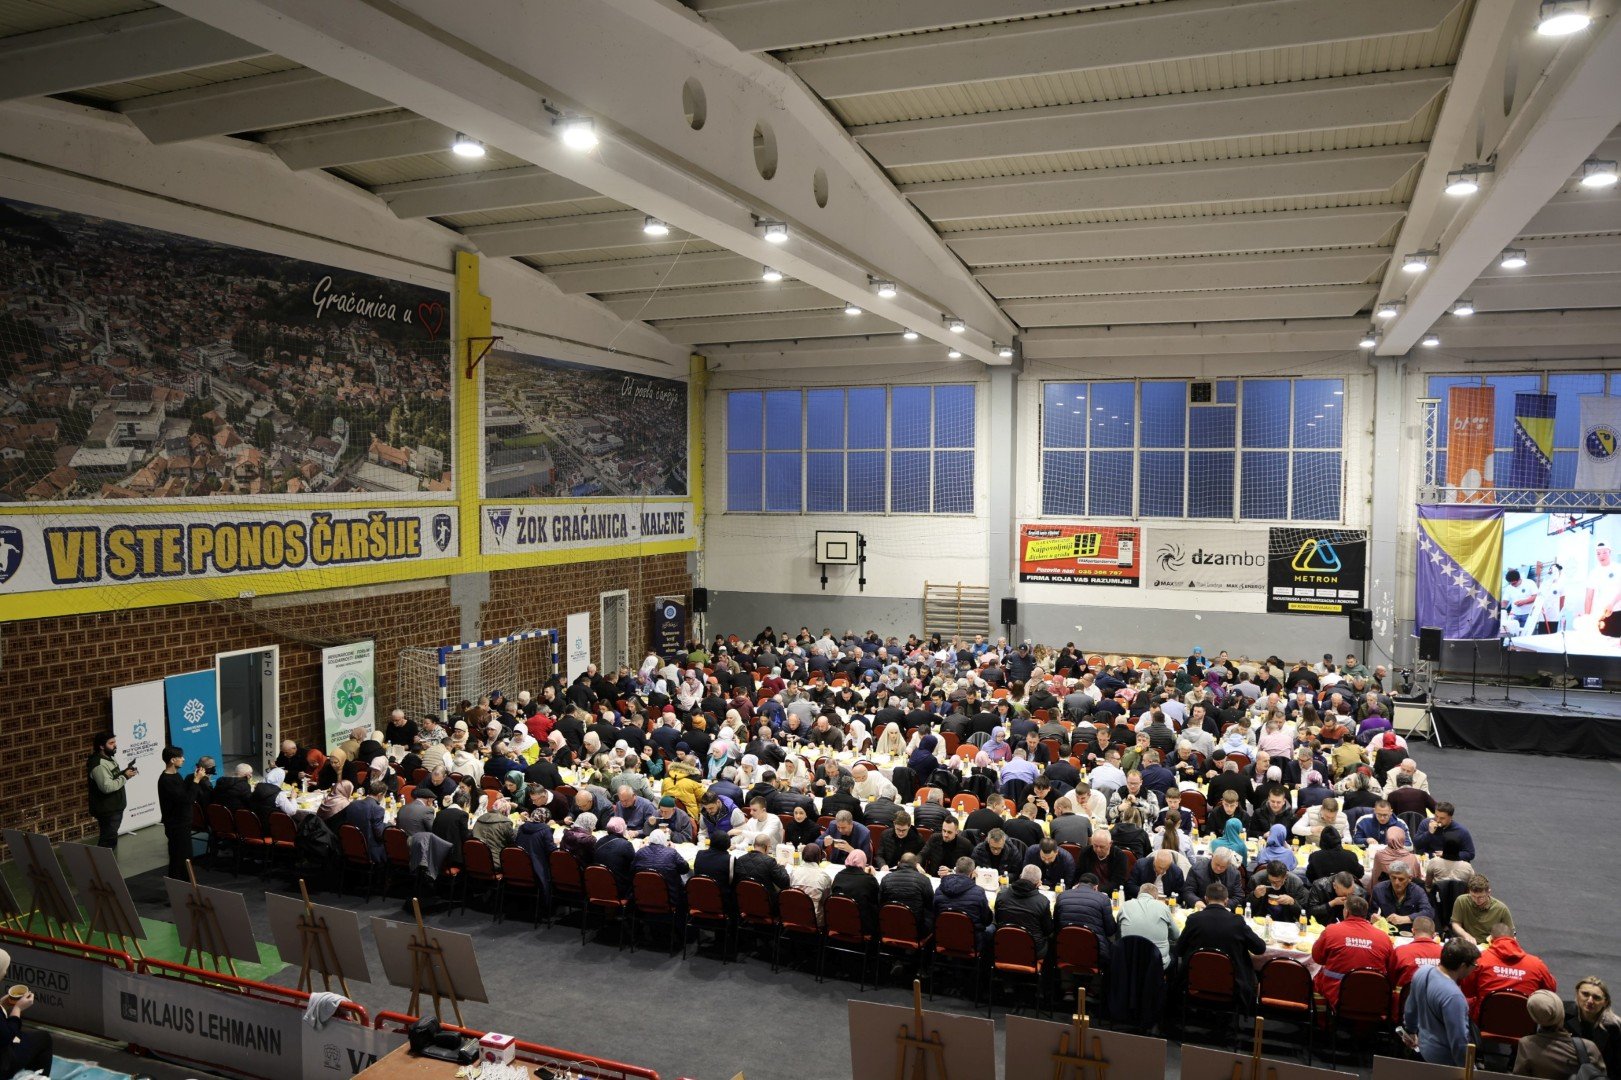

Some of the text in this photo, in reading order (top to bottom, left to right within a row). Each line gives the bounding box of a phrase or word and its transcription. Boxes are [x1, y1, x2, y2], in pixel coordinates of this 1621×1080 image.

[312, 275, 412, 324] Gračanica u
[516, 507, 548, 545] ŽOK
[552, 506, 628, 543] GRAČANICA
[640, 511, 685, 537] MALENE
[44, 510, 422, 584] VI STE PONOS ČARŠIJE
[1191, 548, 1266, 567] dzambo
[1091, 577, 1132, 585] RAZUMIJE!
[1294, 575, 1338, 583] METRON
[1345, 936, 1373, 947] SHMP
[1414, 957, 1441, 966] SHMP
[1493, 965, 1527, 977] SHMP
[141, 997, 283, 1057] KLAUS LEHMANN
